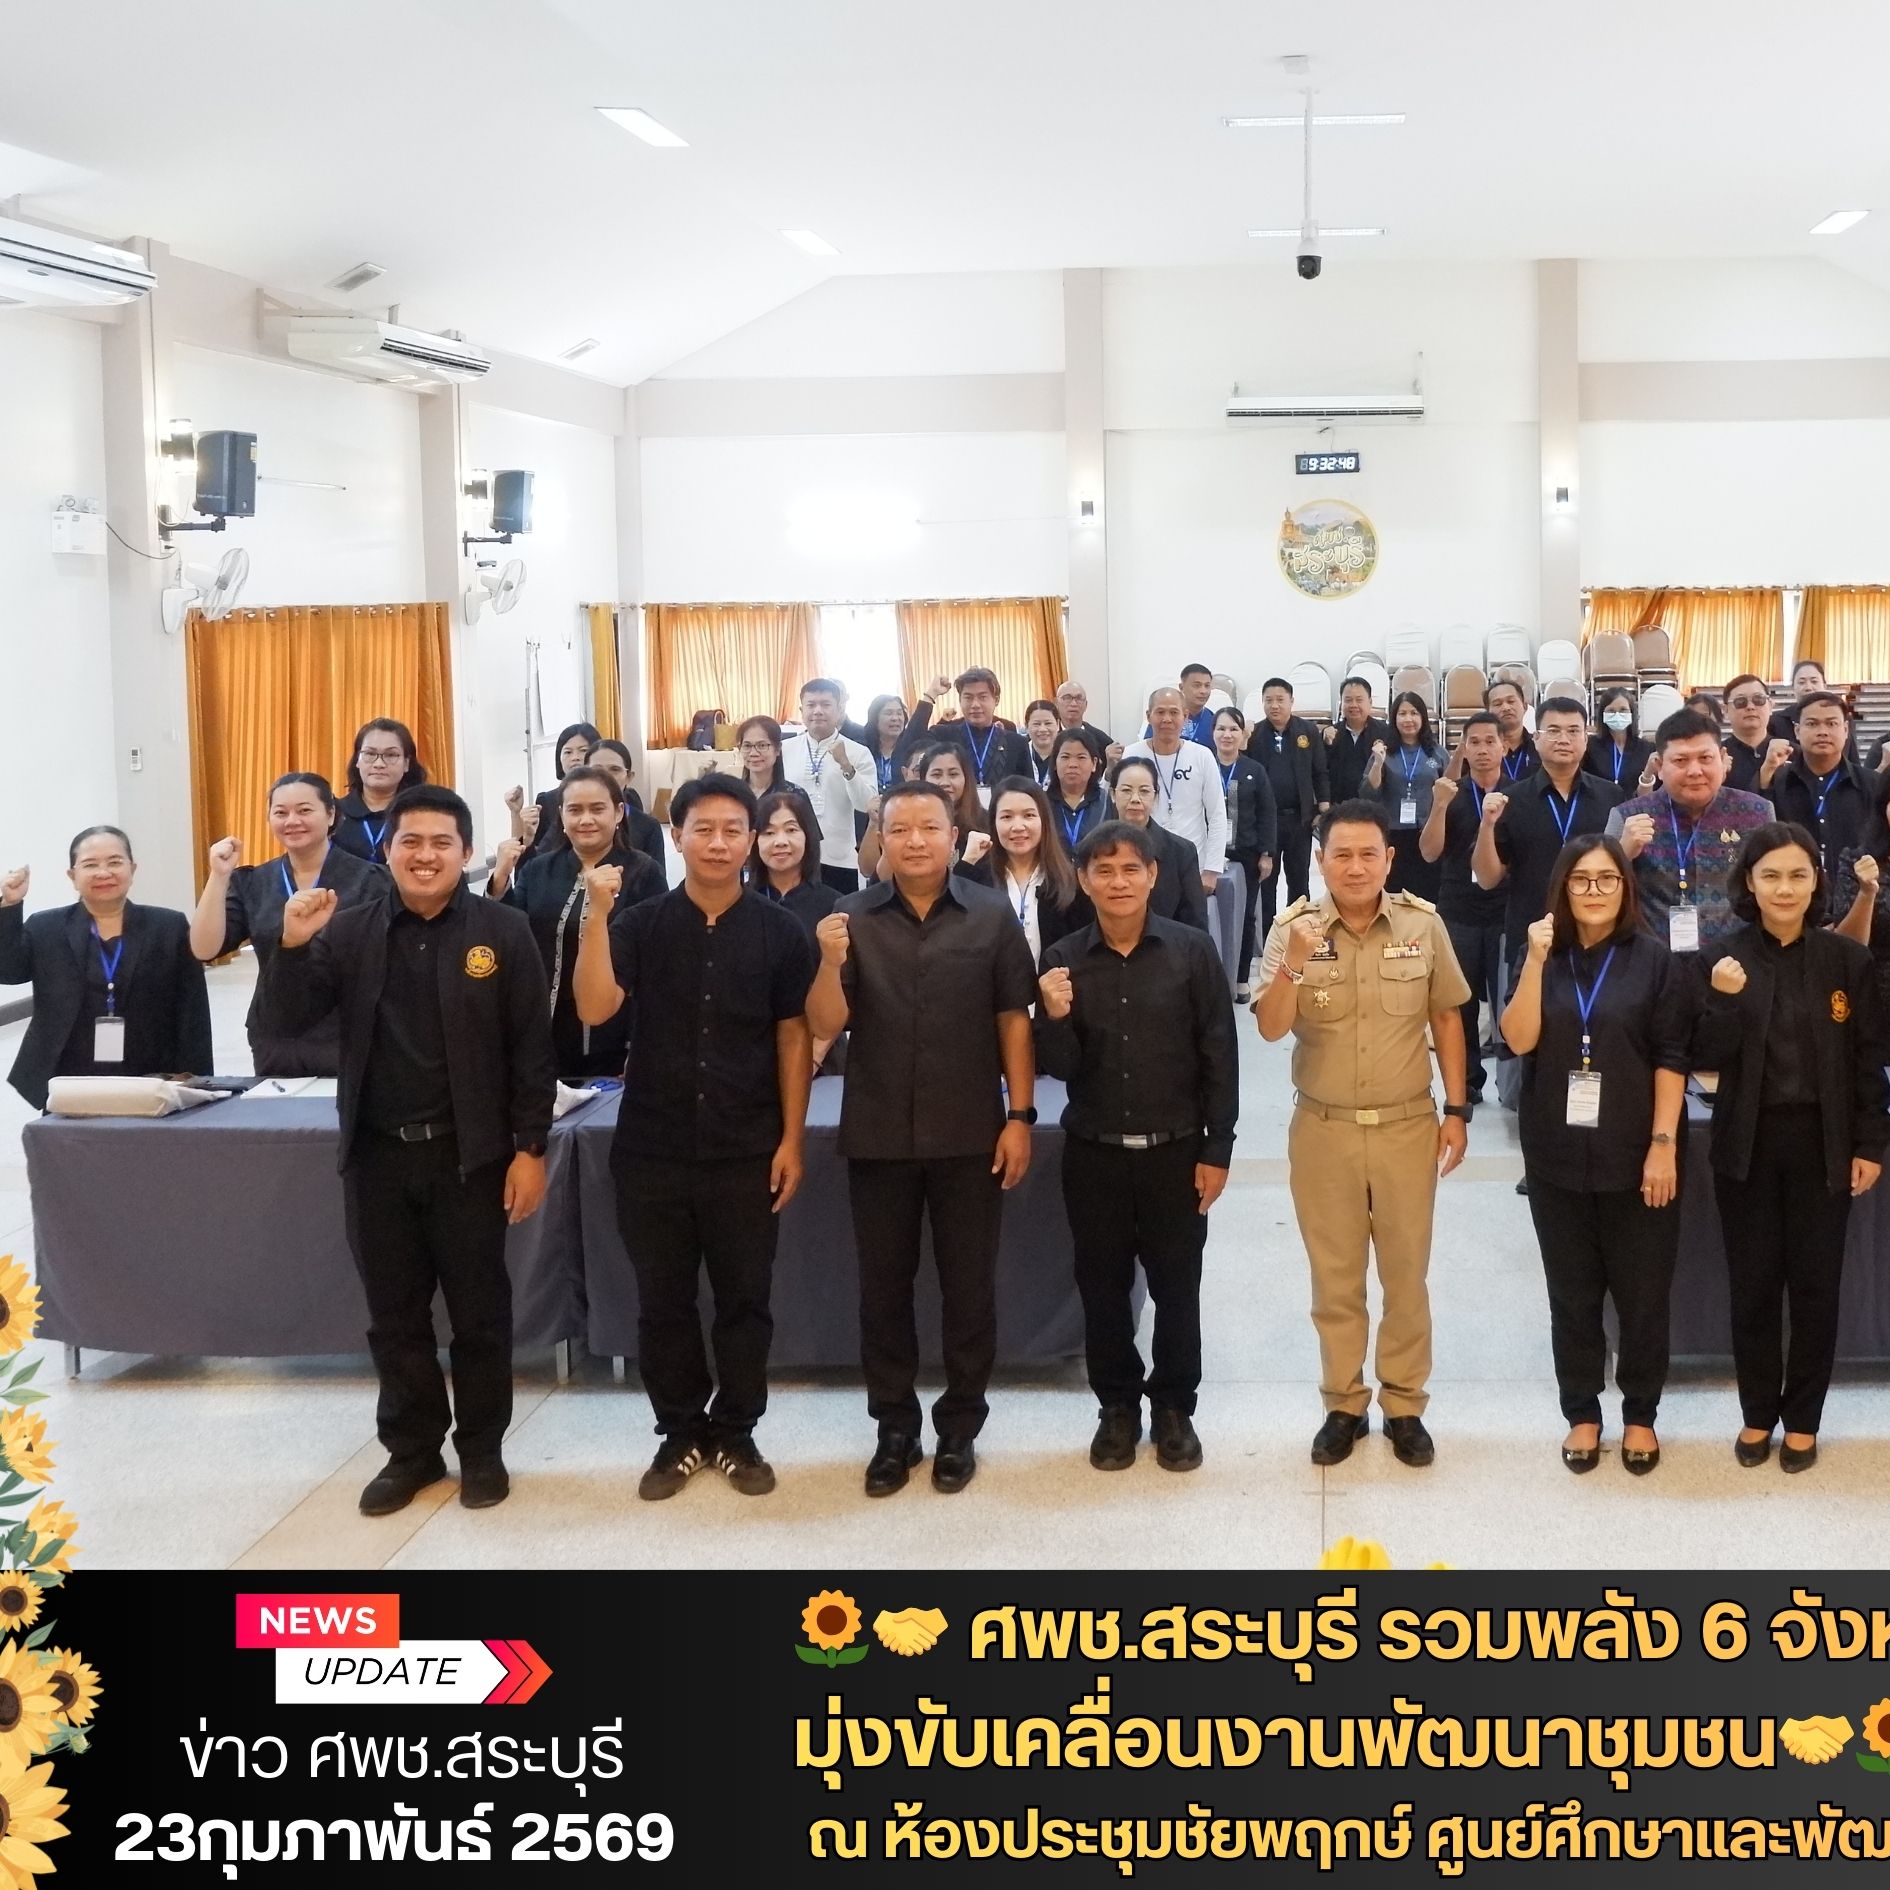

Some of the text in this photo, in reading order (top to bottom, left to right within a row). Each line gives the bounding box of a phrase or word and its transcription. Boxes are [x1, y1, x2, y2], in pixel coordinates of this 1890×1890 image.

[1292, 535, 1367, 575] สระบุรี
[1173, 765, 1193, 781] ๙
